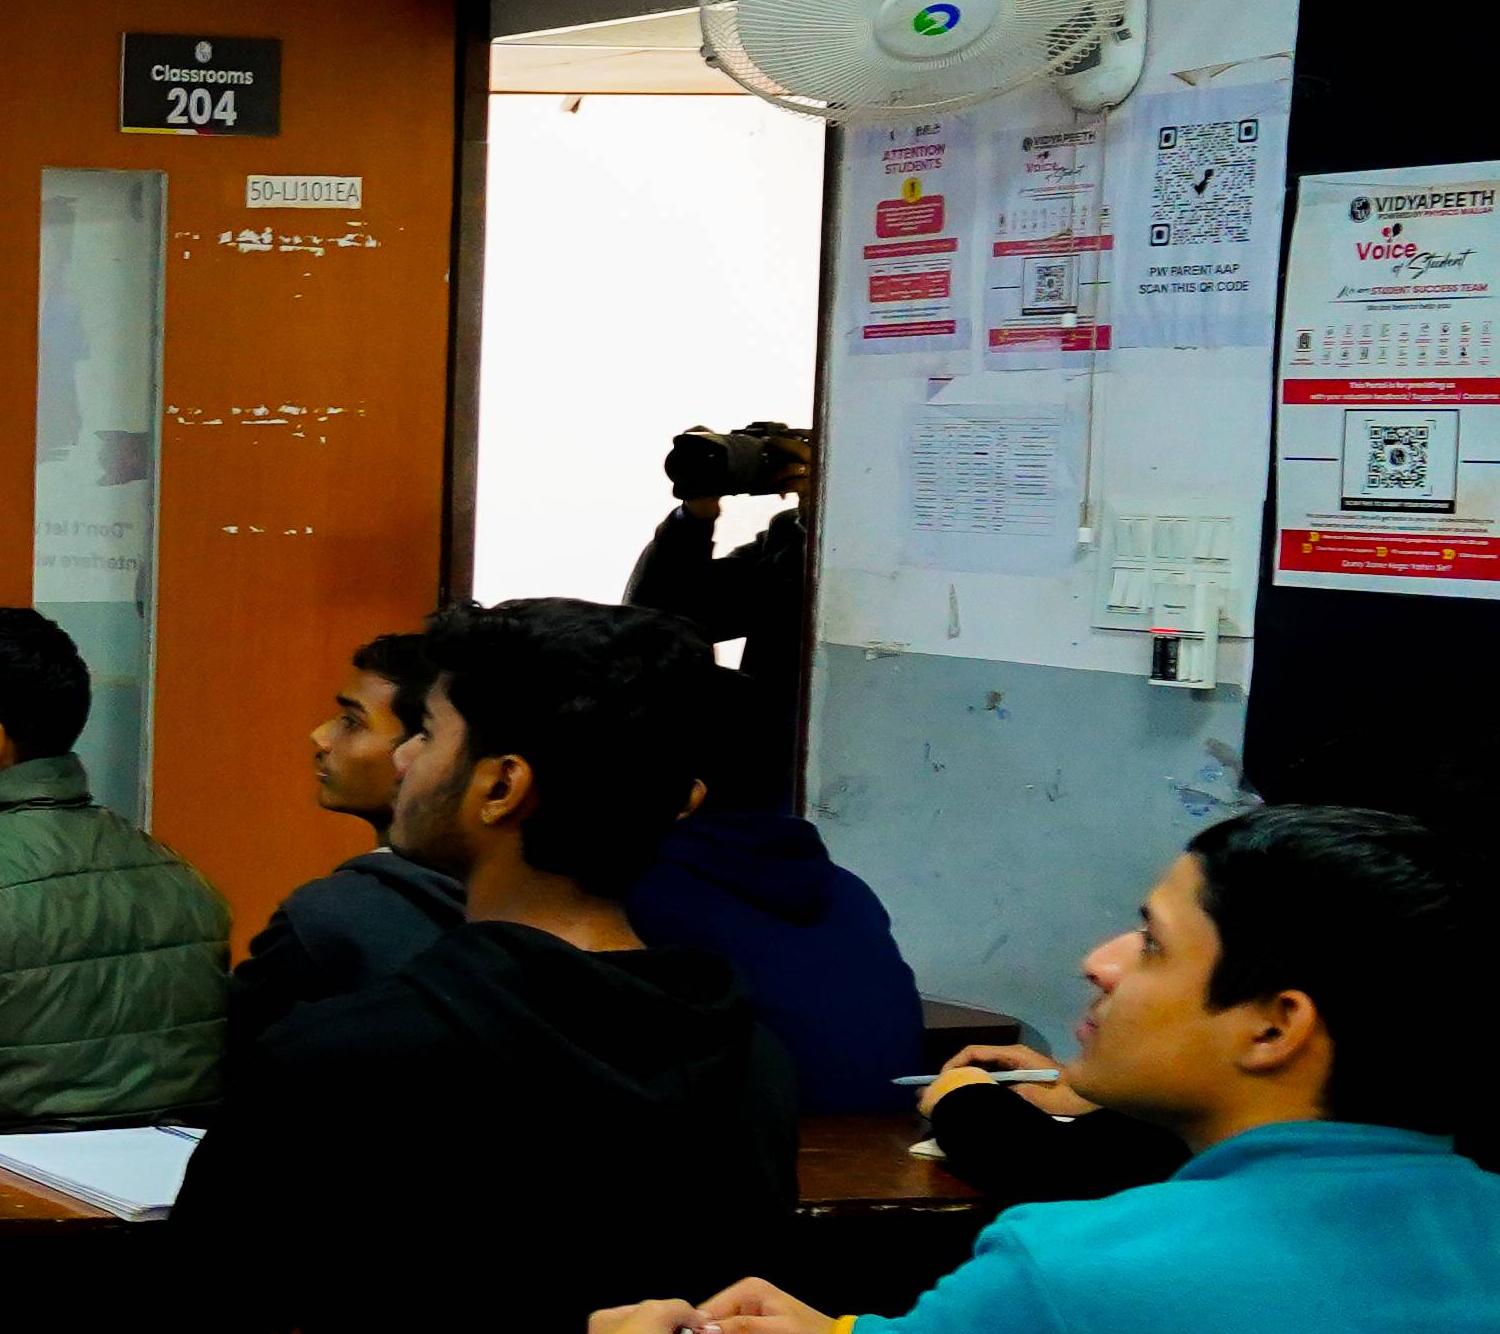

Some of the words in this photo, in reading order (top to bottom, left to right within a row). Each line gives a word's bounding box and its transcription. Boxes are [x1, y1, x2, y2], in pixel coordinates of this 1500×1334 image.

[151, 65, 254, 85] Classrooms
[167, 88, 237, 126] 204
[1033, 131, 1096, 148] VIDYAPEETH
[881, 144, 945, 161] ATTENTION
[885, 158, 942, 175] STUDENTS
[1374, 189, 1496, 212] VIDYAPEETH
[1356, 241, 1418, 260] Voice
[1150, 266, 1168, 277] PW
[1171, 265, 1214, 275] PARENT
[1406, 248, 1478, 280] Student
[1138, 284, 1168, 294] SCAN
[1171, 282, 1197, 293] THIS
[1217, 280, 1249, 292] CODE
[1370, 285, 1411, 295] STUDENT
[1413, 284, 1458, 294] SUCCESS
[1460, 283, 1489, 292] TEAM
